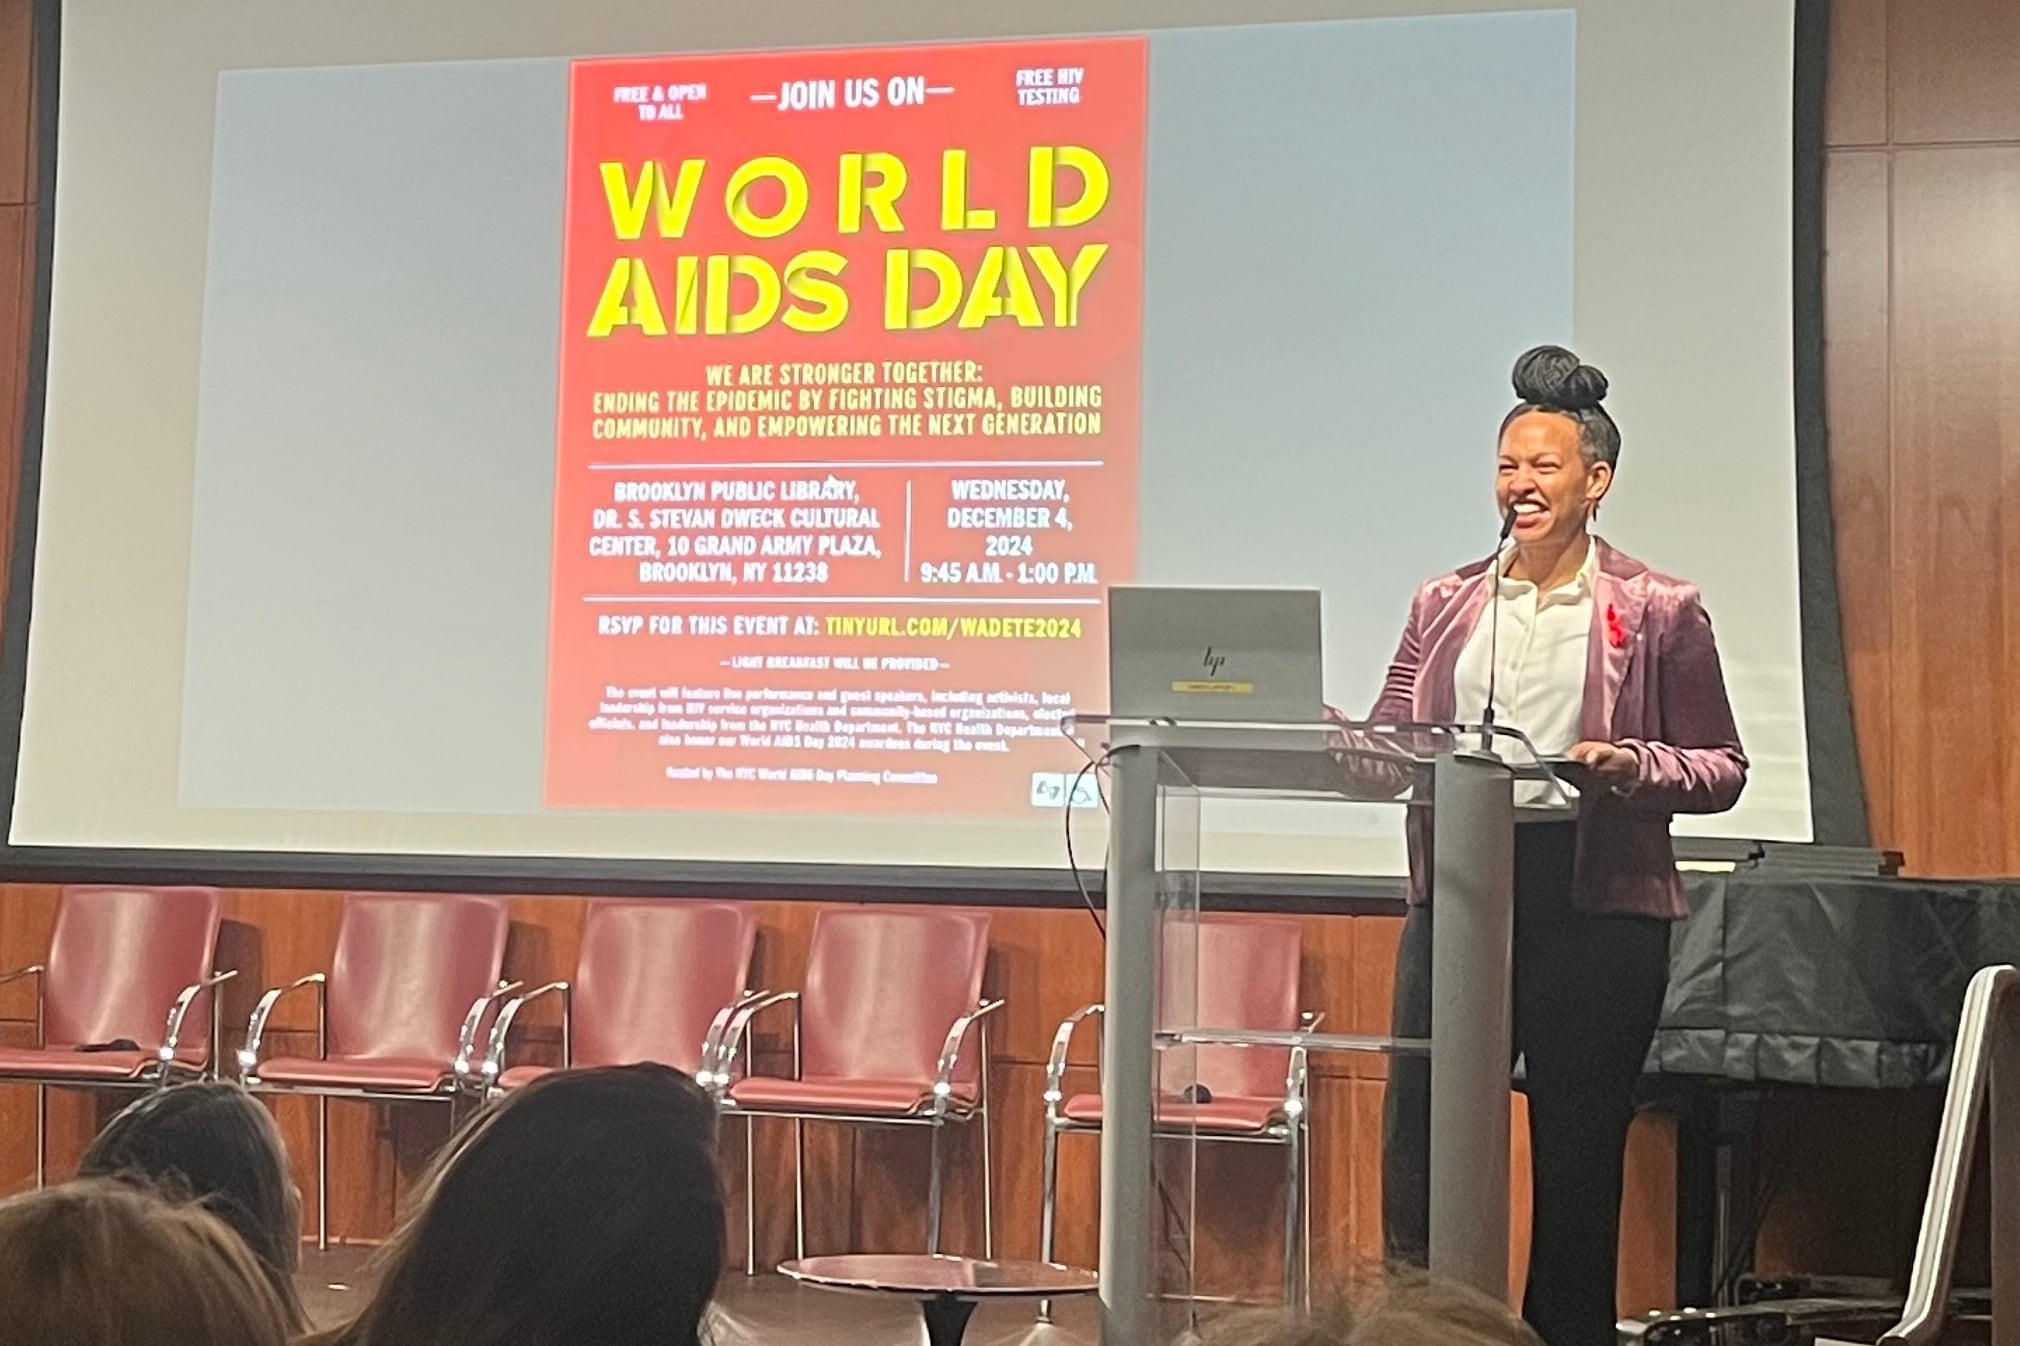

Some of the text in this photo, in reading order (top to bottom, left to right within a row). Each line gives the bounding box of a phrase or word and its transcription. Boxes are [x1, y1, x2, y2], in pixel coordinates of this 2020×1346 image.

[1016, 68, 1084, 86] FREE HIV
[614, 86, 648, 102] FREE
[668, 84, 706, 101] OPEN
[777, 76, 924, 110] JOIN US ON
[1018, 87, 1079, 106] TESTING
[639, 103, 684, 120] TO ALL
[599, 145, 1109, 239] WORLD
[587, 244, 1108, 336] AIDS DAY
[706, 361, 983, 386] WE ARE STRONGER TOGETHER:
[593, 386, 1102, 414] ENDING THE EPIDEMIC BY FIGHTING STIGMA, BUILDING
[592, 412, 1101, 441] COMMUNITY, AND EMPOWERING THE NEXT GENERATION
[614, 480, 860, 503] BROOKLYN PUBLIC LIBRARY,
[952, 480, 1070, 502] WEDNESDAY,
[592, 508, 880, 529] DR. S. STEVAN DWECK CULTURAL
[948, 508, 1072, 531] DECEMBER 4,
[589, 535, 882, 558] CENTER, 10 GRAND ARMY PLAZA,
[985, 535, 1033, 556] 2024
[640, 562, 828, 585] BROOKLYN, NY 11238
[920, 562, 961, 582] 9:45
[966, 562, 1003, 583] A.M.
[1017, 562, 1058, 584] 1:00
[1064, 562, 1098, 584] P.M.
[598, 616, 1081, 640] RSVP FOR THIS EVENT AT: TINYURL.COM/WADETE2024
[732, 656, 763, 668] LIGHT
[766, 656, 830, 669] BREAKFAST
[834, 657, 859, 670] WILL
[863, 657, 878, 670] BE
[1204, 646, 1225, 676] hp
[606, 686, 624, 698] The
[628, 687, 656, 698] event
[660, 687, 678, 698] will
[682, 686, 720, 699] feature
[746, 688, 813, 701] performance
[818, 688, 836, 700] and
[840, 690, 871, 704] guest
[874, 690, 927, 704] speakers,
[931, 690, 983, 705] including
[1042, 691, 1071, 704] local
[600, 702, 655, 715] leadership
[658, 702, 682, 713] from
[686, 702, 704, 714] HIV
[708, 702, 746, 714] service
[750, 704, 823, 717] organizations
[827, 704, 846, 716] and
[850, 705, 948, 720] community-based
[950, 708, 1028, 720] organizations,
[639, 718, 658, 730] and
[662, 718, 716, 732] leadership
[721, 719, 745, 731] from
[750, 720, 766, 731] the
[770, 720, 792, 731] NYC
[796, 720, 830, 732] Health
[834, 720, 901, 734] Department.
[906, 722, 926, 734] The
[930, 722, 950, 734] NYC
[956, 722, 992, 735] Health
[659, 736, 681, 746] also
[684, 734, 715, 746] honor
[718, 736, 736, 746] our
[740, 736, 770, 746] World
[774, 736, 801, 747] AIDS
[804, 736, 824, 749] Day
[828, 736, 855, 748] 2024
[914, 739, 950, 753] during
[954, 739, 973, 751] the
[758, 768, 786, 780] World
[816, 768, 834, 782] Day
